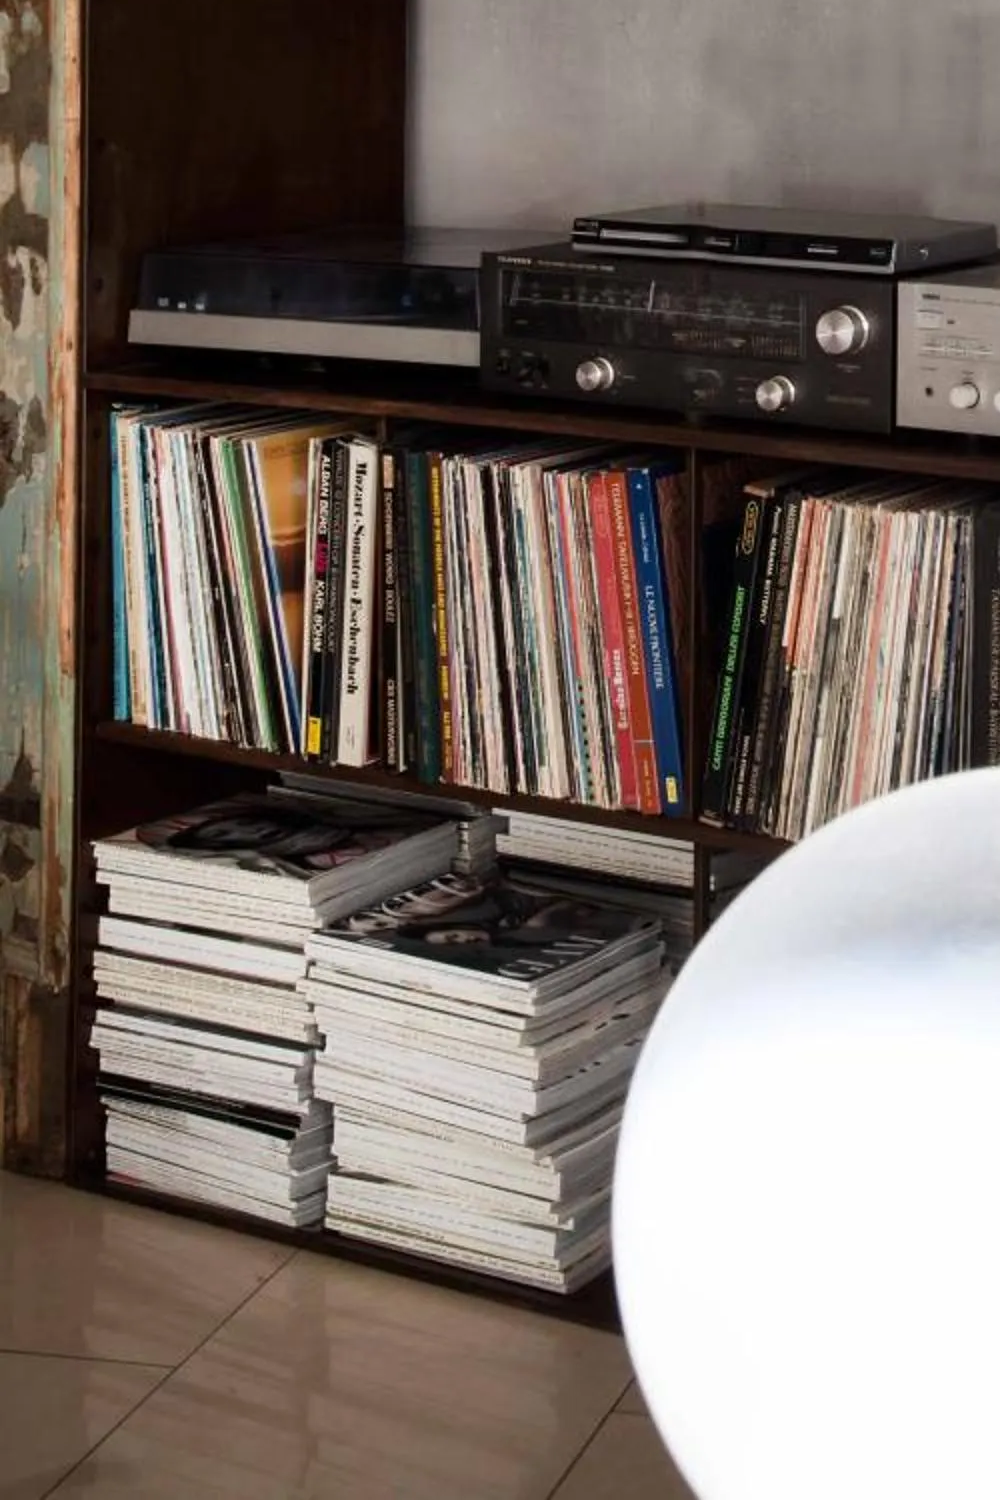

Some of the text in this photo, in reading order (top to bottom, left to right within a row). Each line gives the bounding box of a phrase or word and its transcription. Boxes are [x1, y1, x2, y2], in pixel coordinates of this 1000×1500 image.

[320, 455, 331, 496] ALBAN
[318, 500, 329, 535] BERG
[314, 580, 325, 612] KARL
[347, 461, 367, 695] Mozart Sonaten Eschenbach
[759, 579, 771, 625] BUTTERFLY
[644, 585, 665, 690] LE NUOVE FRONTIERE
[724, 634, 741, 672] DELLER
